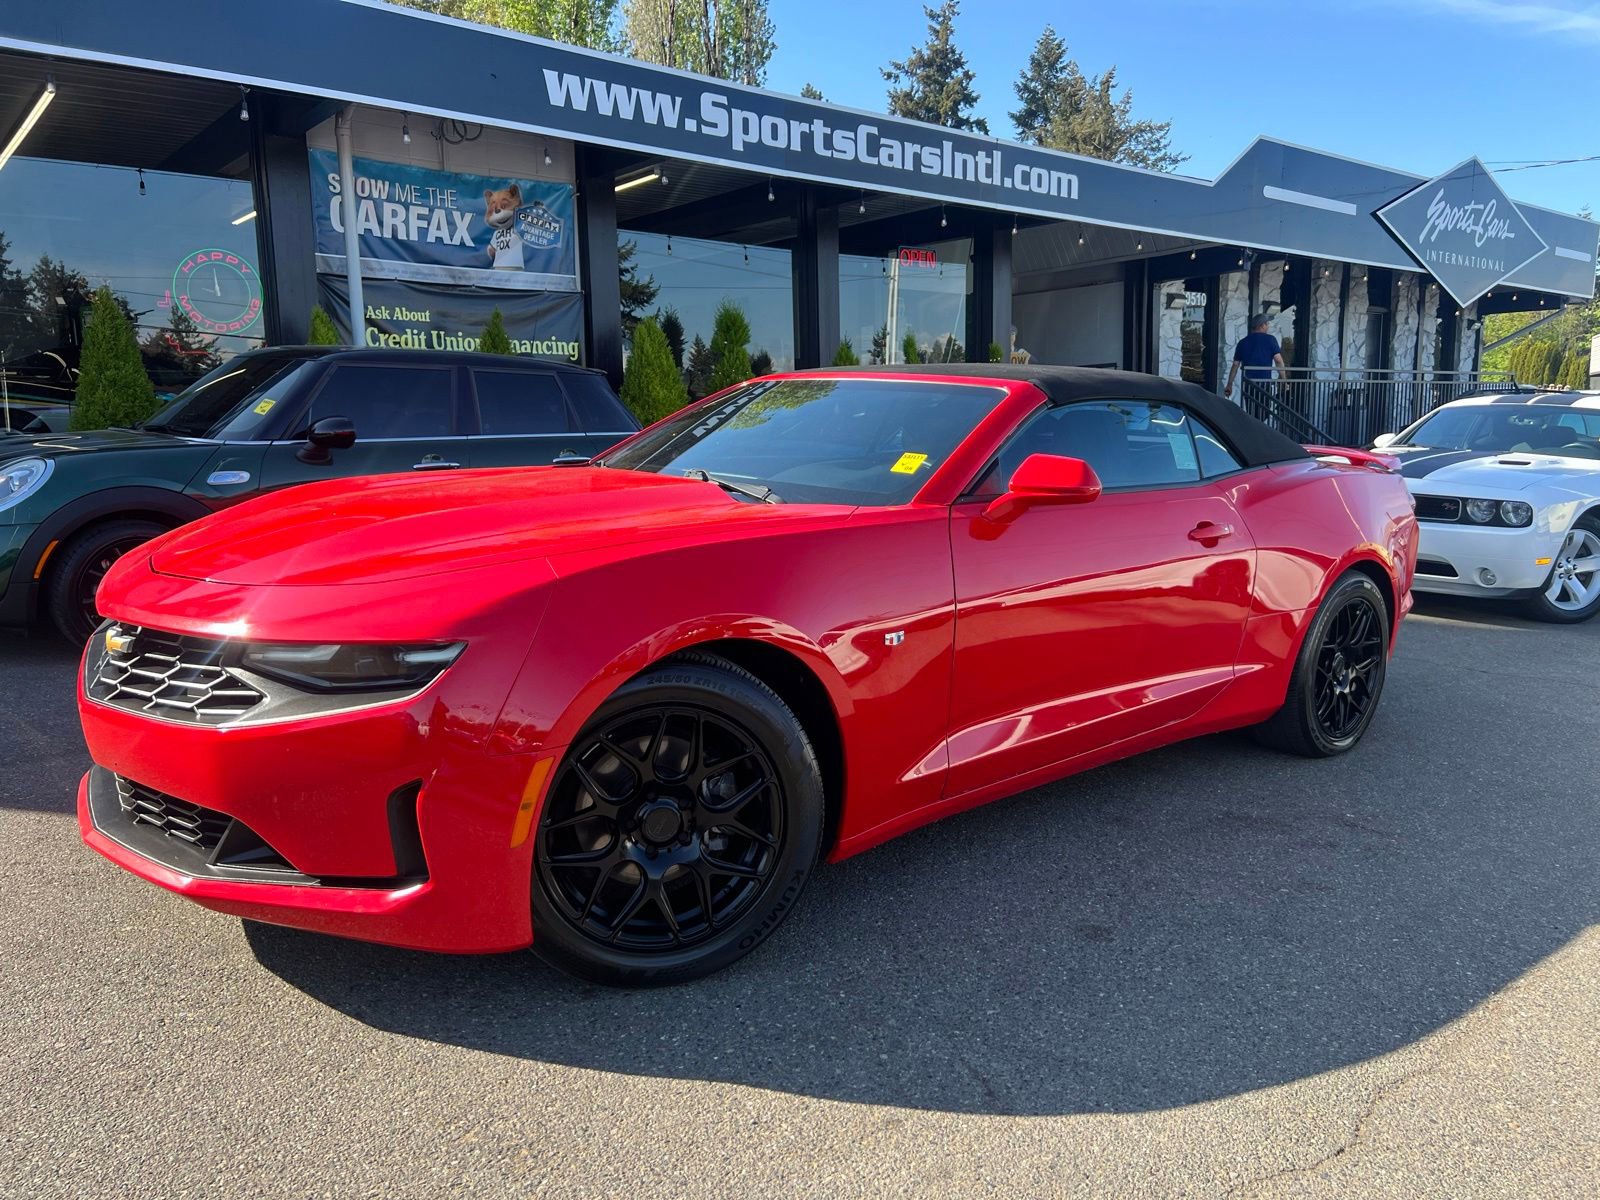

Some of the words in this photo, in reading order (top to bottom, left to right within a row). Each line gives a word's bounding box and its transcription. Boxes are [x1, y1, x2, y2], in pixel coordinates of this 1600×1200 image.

[327, 173, 389, 200] SOW
[395, 182, 421, 206] ME
[425, 186, 457, 209] THE
[519, 213, 559, 232] CARFAX
[521, 223, 555, 240] ADVANTAGE
[496, 239, 511, 250] FOX
[523, 233, 548, 246] DEALER
[181, 252, 251, 273] HAPPY
[900, 248, 937, 270] OPEN
[1426, 248, 1505, 273] INTERNATIONAL
[179, 295, 260, 332] MOTORING
[366, 305, 391, 320] Ask
[393, 307, 431, 322] About
[365, 326, 427, 350] Credit
[509, 335, 579, 360] nancing
[738, 869, 805, 950] KUMHO
